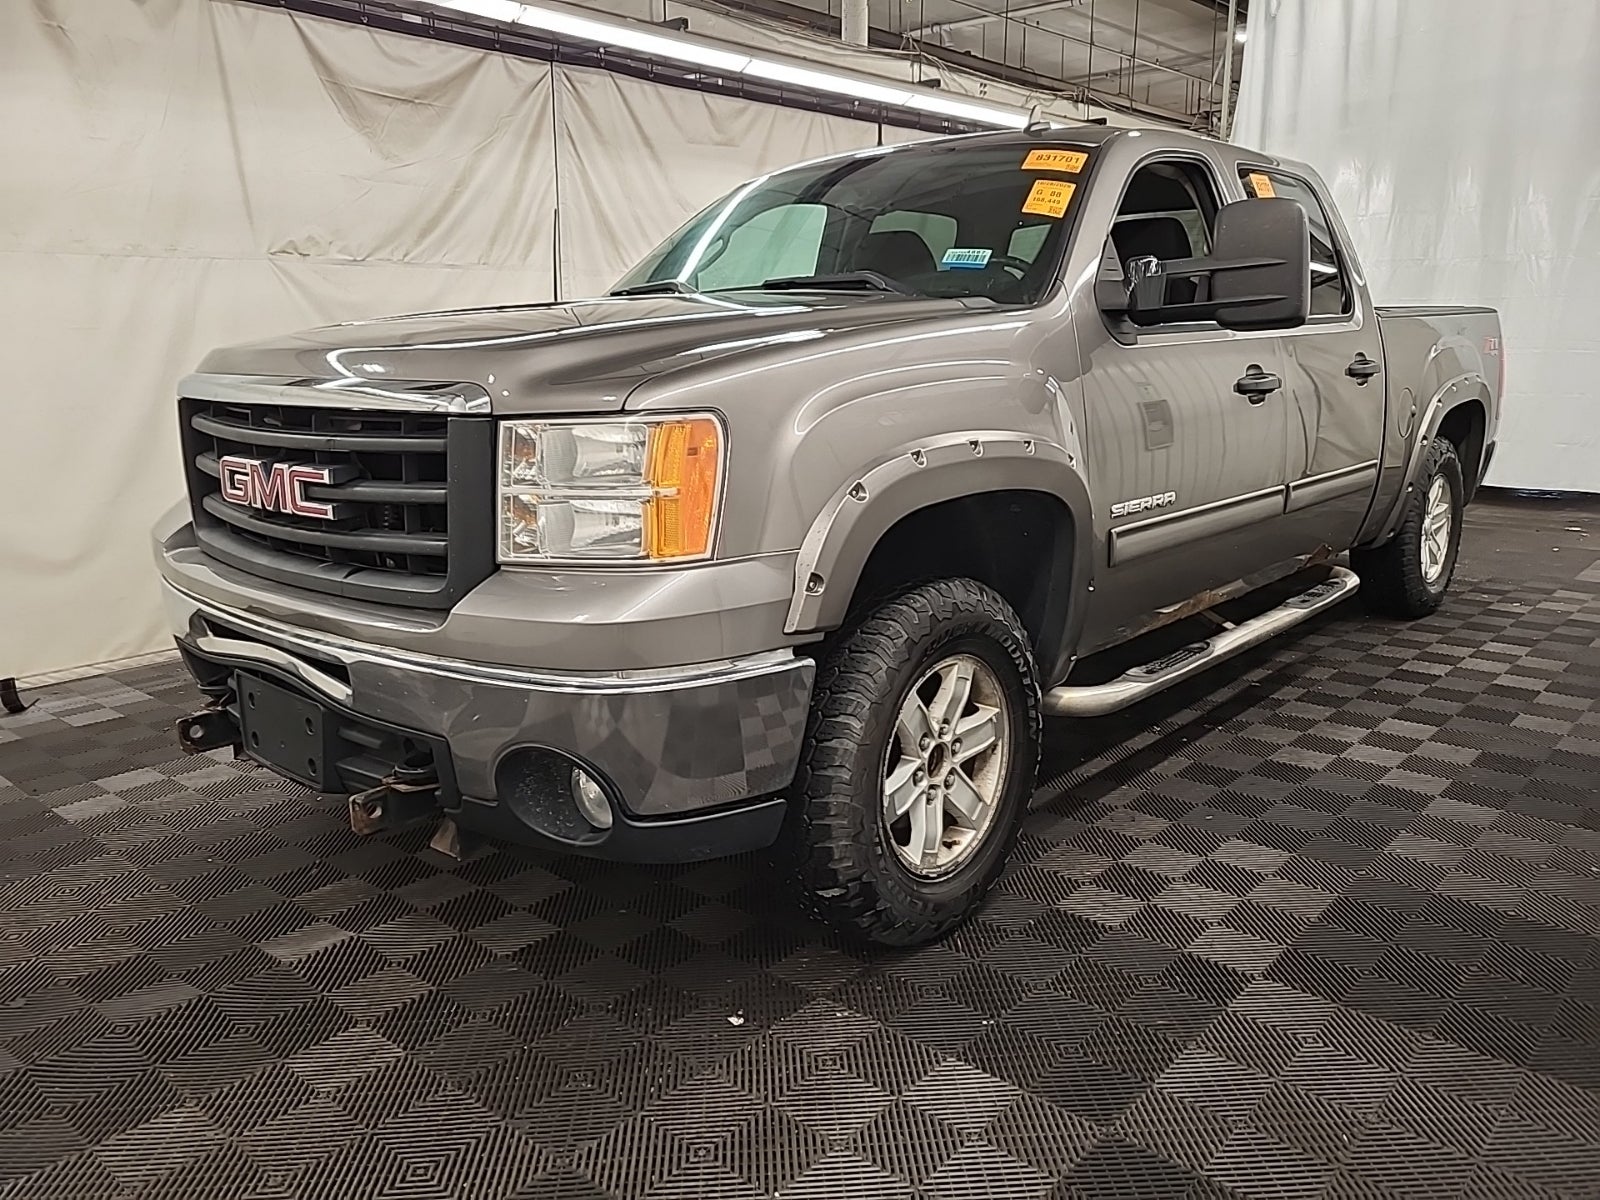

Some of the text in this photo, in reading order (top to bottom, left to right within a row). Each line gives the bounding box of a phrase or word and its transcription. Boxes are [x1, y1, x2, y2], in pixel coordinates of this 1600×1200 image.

[1036, 154, 1080, 164] 831701
[220, 456, 334, 520] GMC
[1110, 491, 1176, 519] SIERRA
